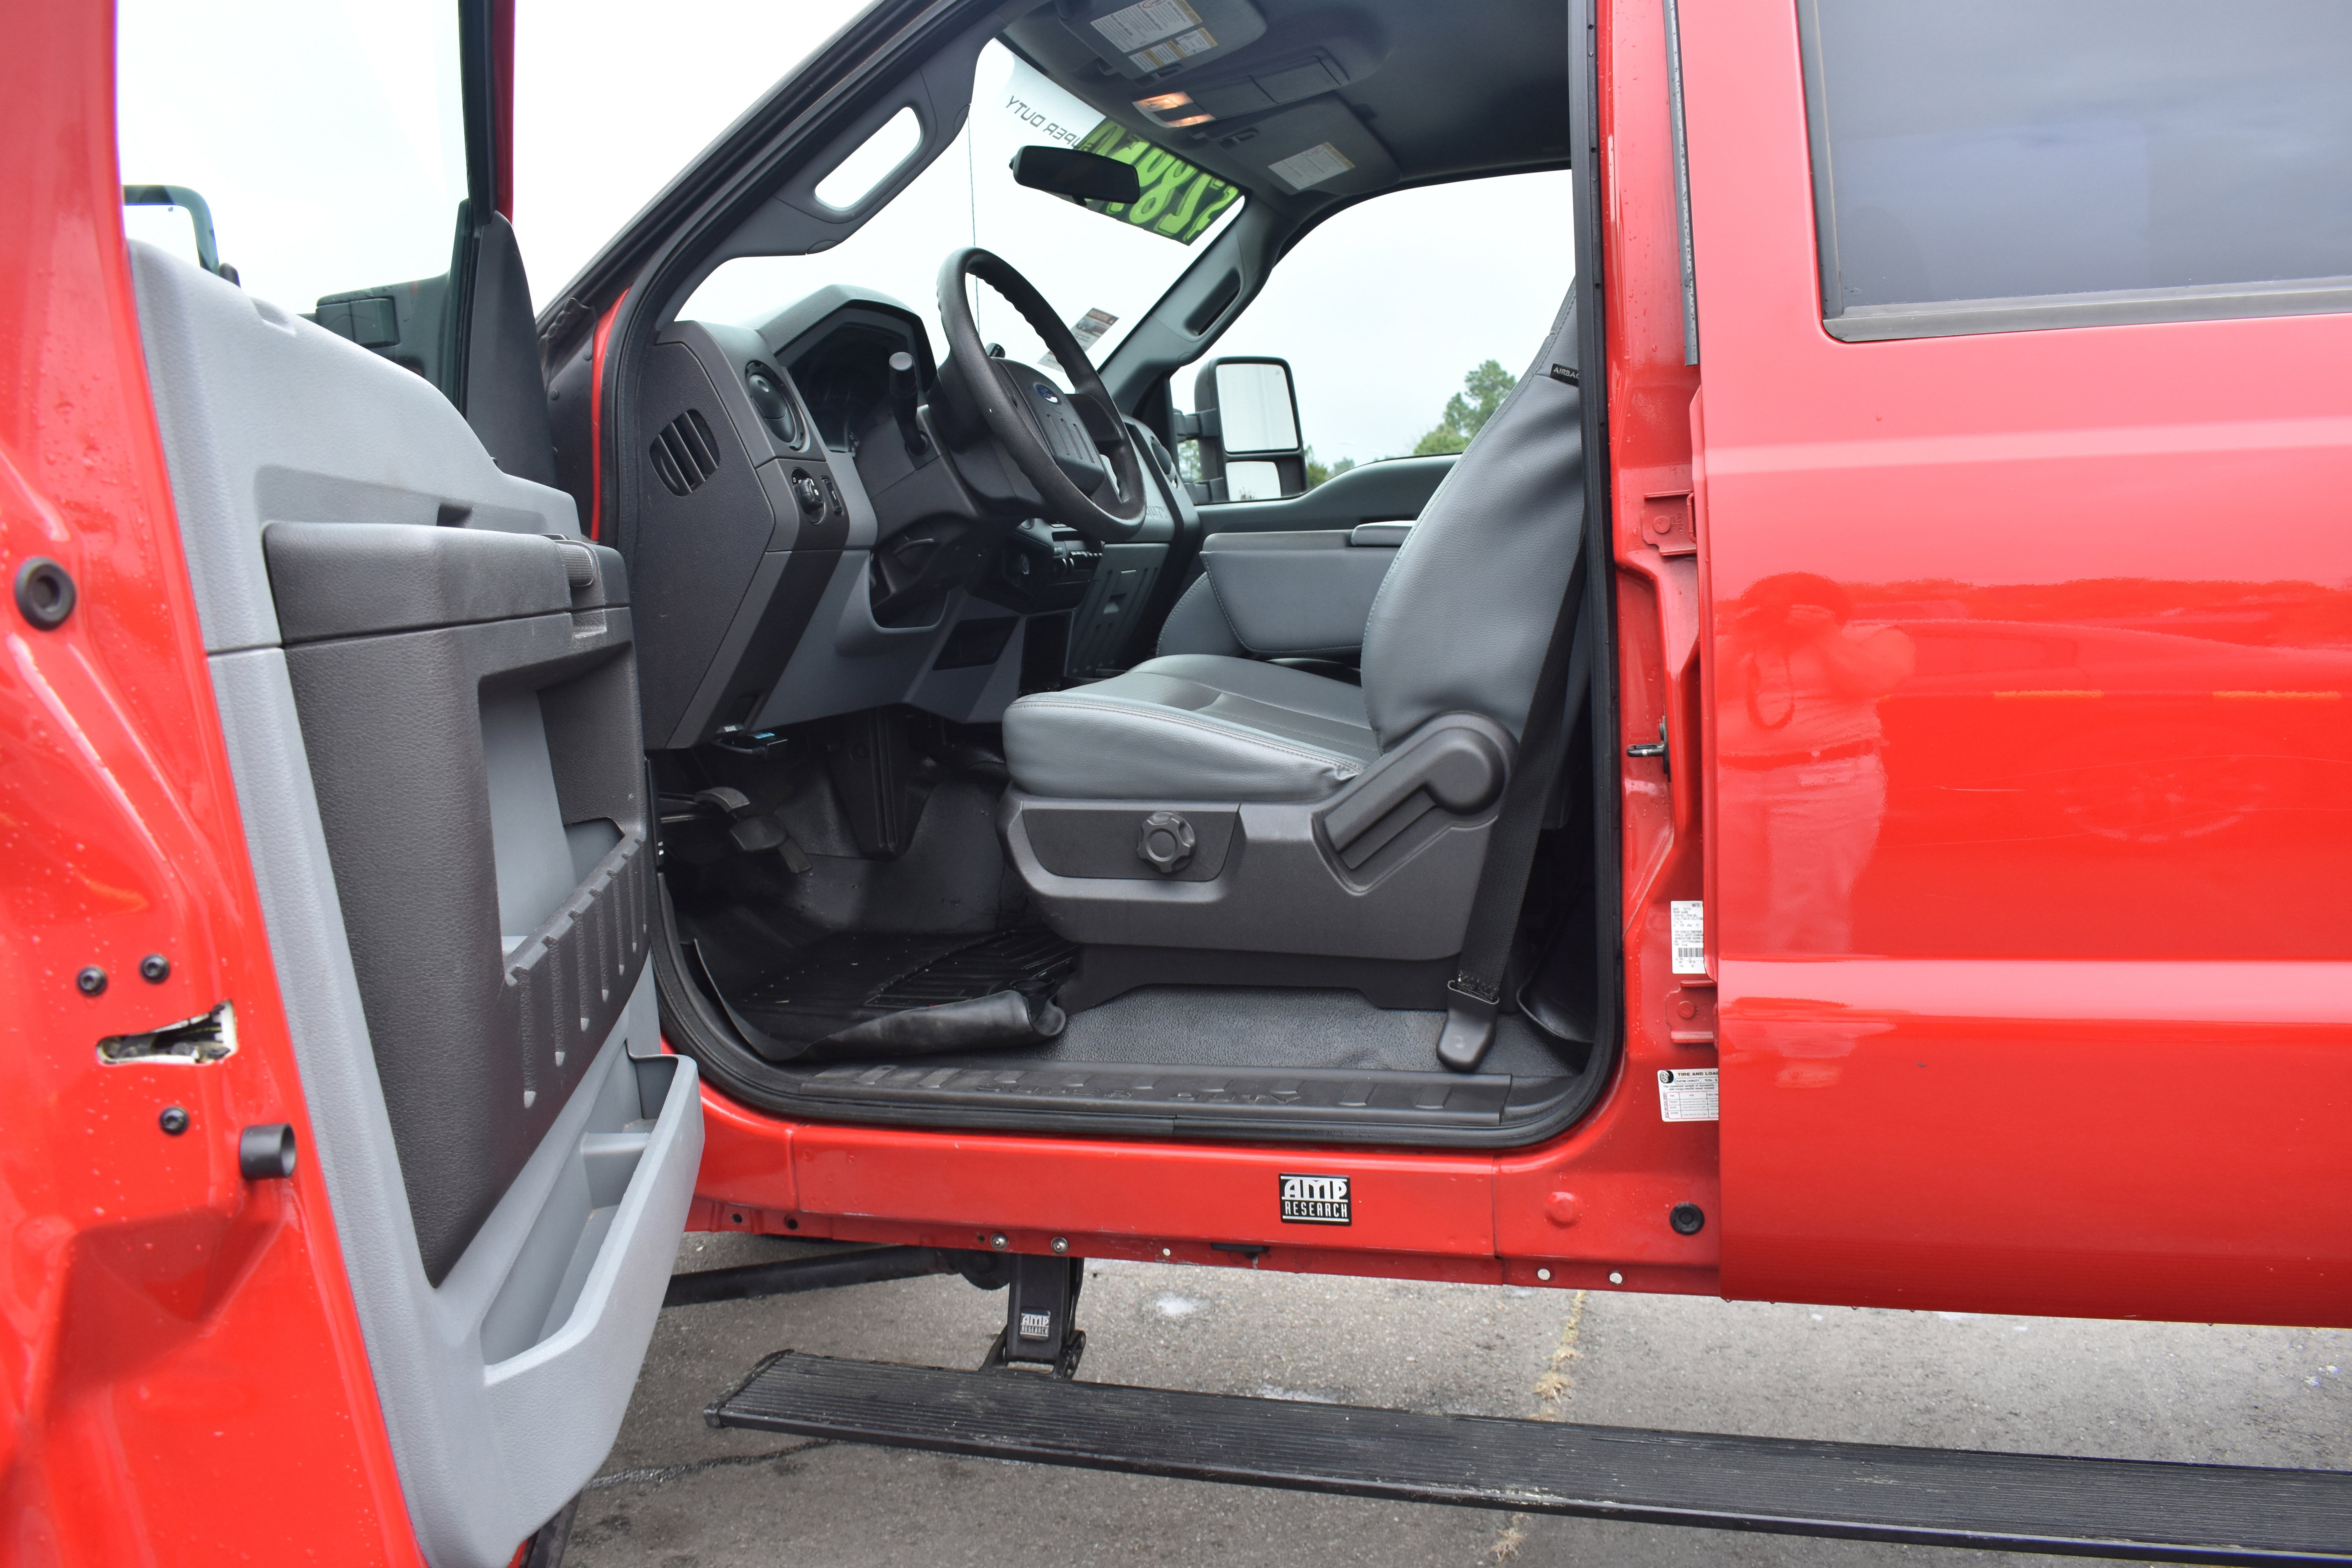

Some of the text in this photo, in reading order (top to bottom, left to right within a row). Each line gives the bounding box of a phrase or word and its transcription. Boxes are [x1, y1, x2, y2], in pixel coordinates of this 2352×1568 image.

[1284, 1178, 1348, 1202] AMP
[1285, 1201, 1348, 1218] RESEARCH
[1022, 1315, 1049, 1327] AMP
[1021, 1325, 1048, 1334] RESEARCH
